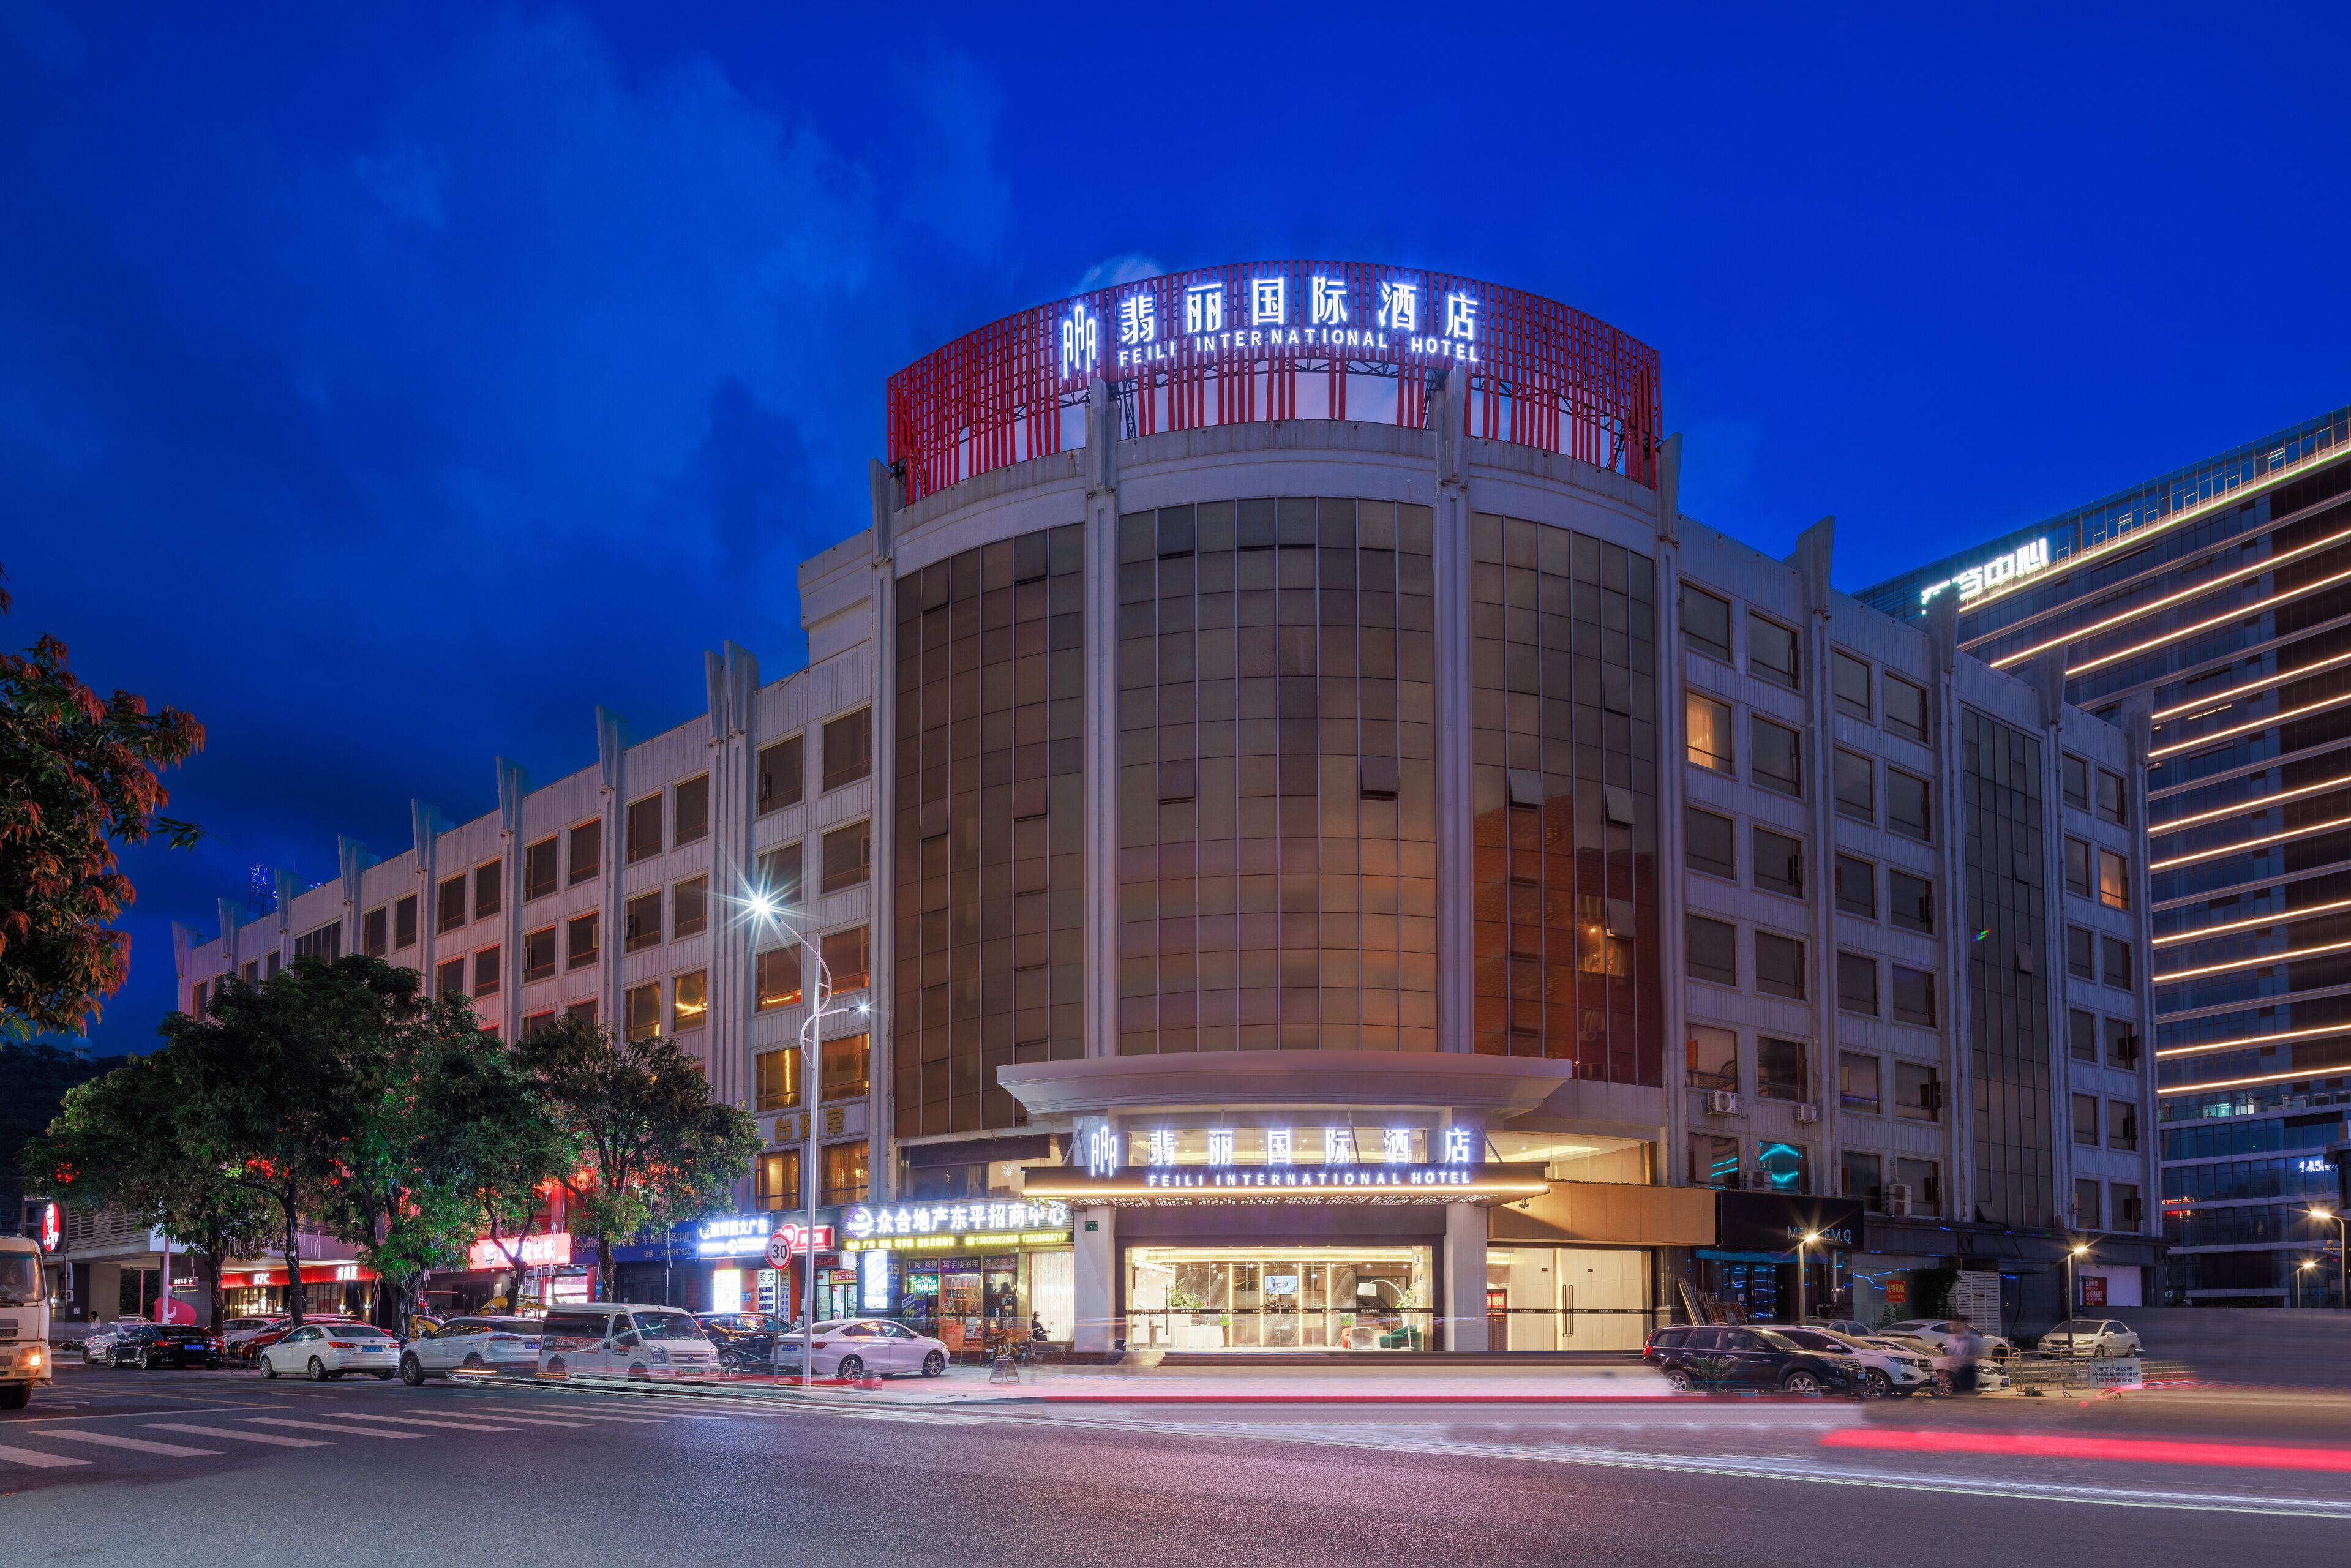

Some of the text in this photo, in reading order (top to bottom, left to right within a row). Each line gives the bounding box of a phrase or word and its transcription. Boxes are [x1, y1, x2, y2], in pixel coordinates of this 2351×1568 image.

[1121, 276, 1477, 345] 翡丽国际酒店
[1119, 329, 1479, 366] FEILI INTERNATIONAL HOTEL
[1150, 1128, 1469, 1165] 翡丽国际酒店
[1149, 1171, 1470, 1187] FEILI INTERNATIONAL HOTEL
[877, 1202, 1067, 1234] 众合地产东平招商中心
[800, 1233, 823, 1244] 美佳
[771, 1244, 787, 1259] 30
[888, 1263, 900, 1275] 35
[943, 1259, 980, 1269] 写字楼招租
[253, 1273, 271, 1285] KFC
[759, 1271, 775, 1282] 图文
